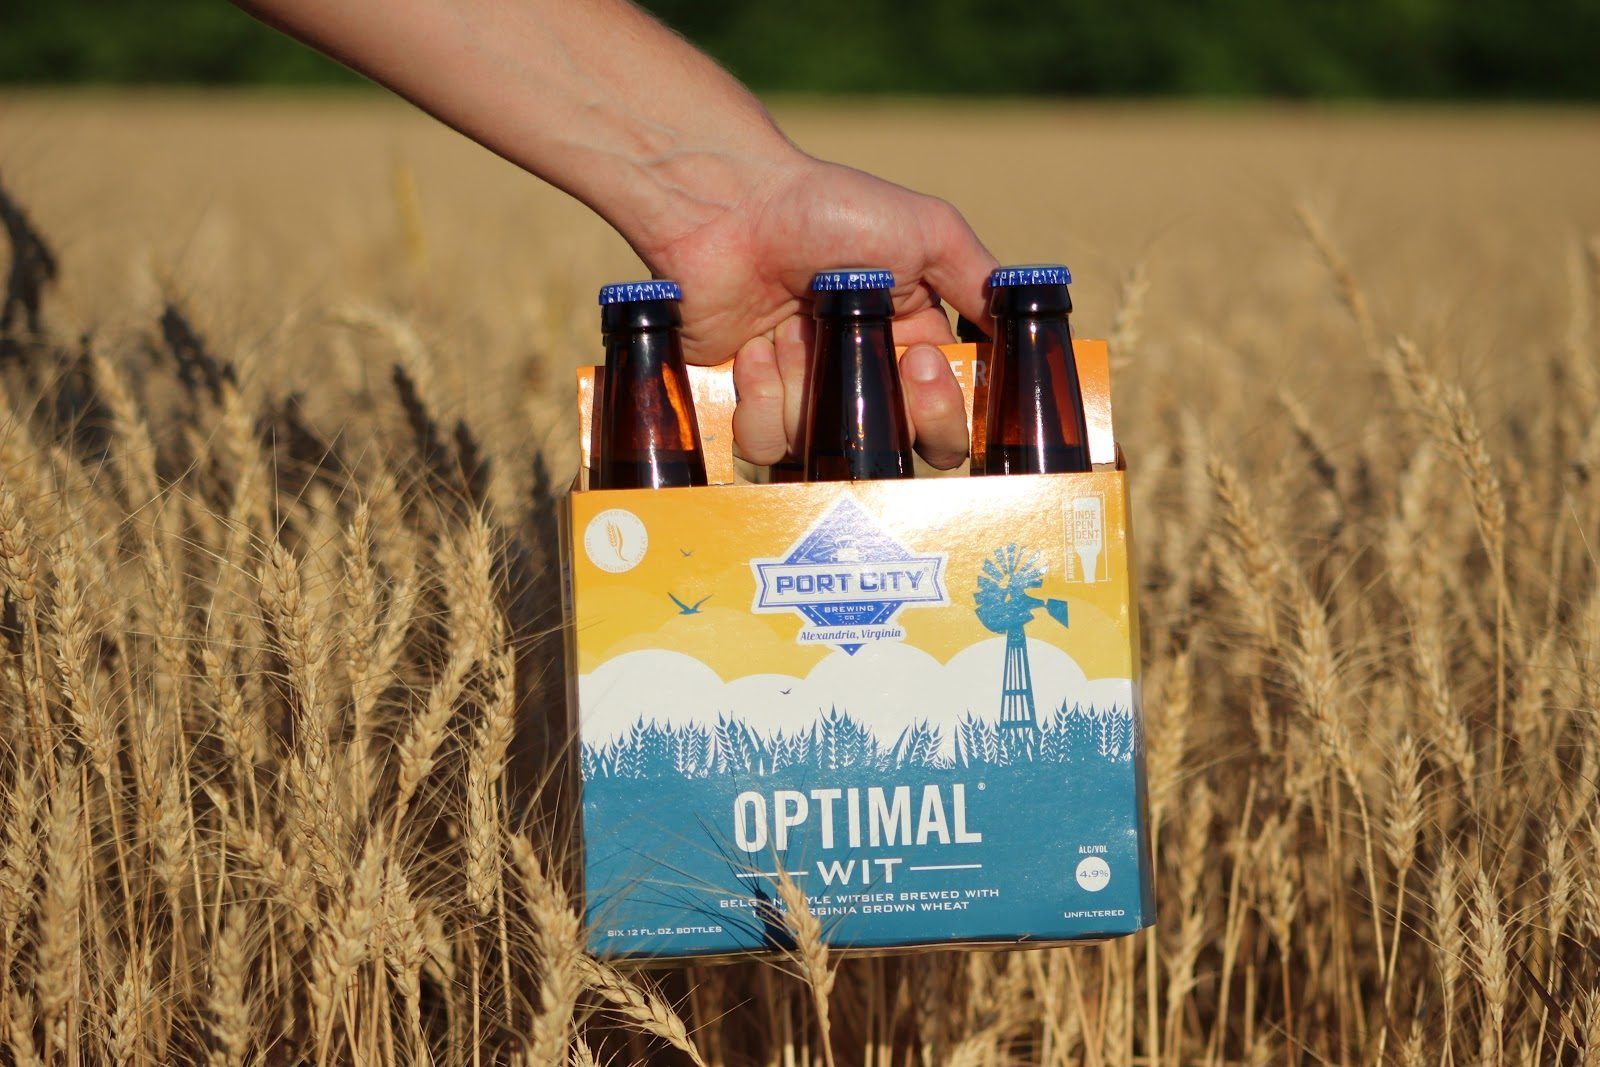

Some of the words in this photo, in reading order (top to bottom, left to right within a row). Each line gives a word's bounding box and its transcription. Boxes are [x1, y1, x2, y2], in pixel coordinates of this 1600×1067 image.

[776, 573, 853, 595] PORT
[859, 570, 924, 592] CITY
[824, 605, 875, 614] BREWING
[800, 630, 859, 641] Alexandria,
[861, 628, 902, 641] Virginia
[734, 783, 982, 852] OPTIMAL
[1078, 845, 1109, 854] ALC/VOL
[816, 858, 903, 886] WIT
[1080, 869, 1109, 878] 4.9%
[720, 898, 783, 908] BELGN
[836, 893, 895, 904] WITBIER
[900, 890, 960, 901] BREWED
[965, 889, 999, 898] WITH
[862, 903, 916, 914] GROWN
[920, 901, 969, 911] WHEAT
[1064, 909, 1125, 918] UNFILTERED
[640, 928, 656, 936] FL.
[676, 926, 722, 934] BOTTLES
